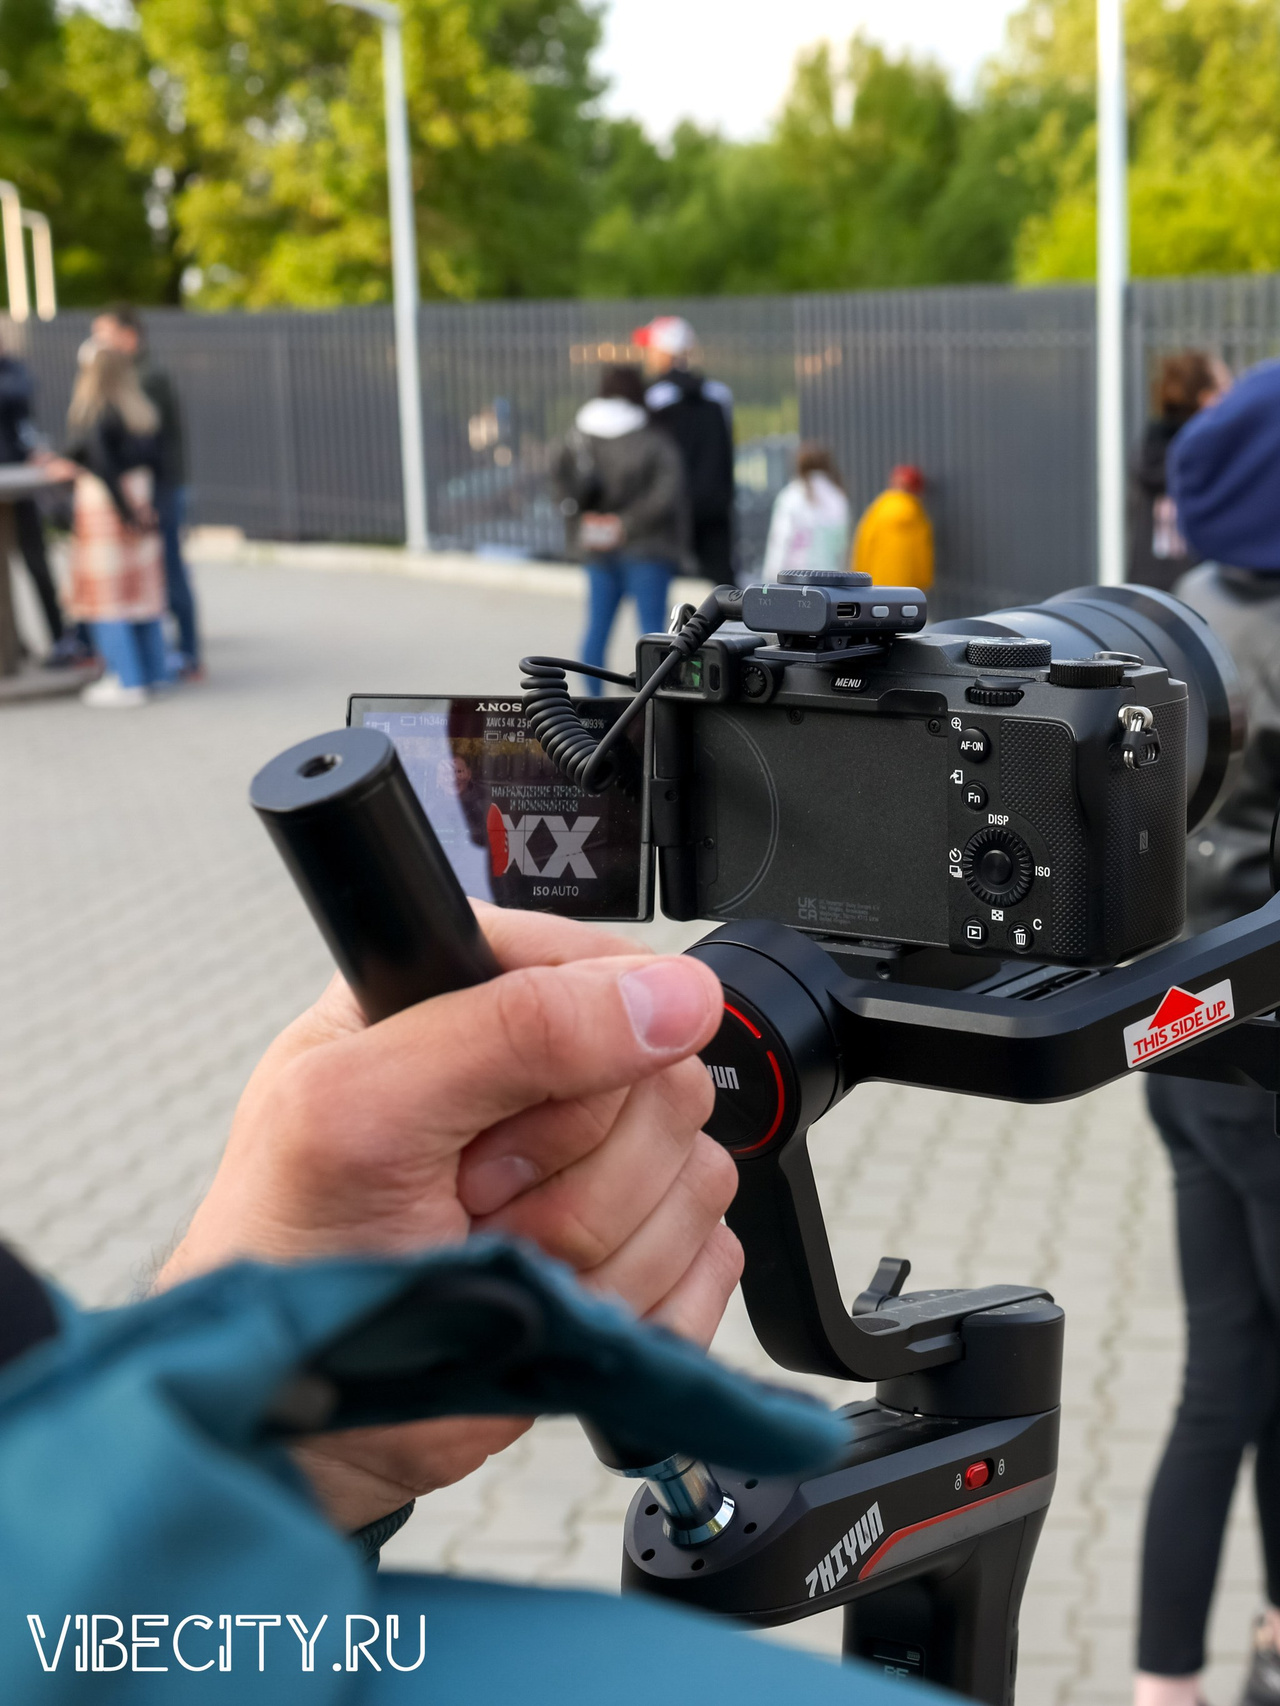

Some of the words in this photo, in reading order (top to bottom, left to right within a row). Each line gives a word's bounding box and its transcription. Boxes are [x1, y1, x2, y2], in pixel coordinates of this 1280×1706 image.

[759, 598, 772, 606] TX1
[798, 600, 812, 609] TX2
[834, 677, 862, 688] MENU
[475, 702, 522, 712] SONY
[419, 715, 448, 726] 1h34m
[507, 717, 515, 727] 4K
[589, 718, 604, 729] 93%
[961, 740, 983, 751] AF-ON
[968, 793, 981, 803] Fn
[988, 814, 1009, 825] DISP
[1035, 866, 1050, 877] ISO
[533, 887, 549, 896] ISO
[551, 886, 579, 896] AUTO
[1033, 919, 1042, 930] C
[1133, 1028, 1168, 1056] THIS
[1171, 1011, 1203, 1038] SIDE
[1206, 1000, 1226, 1021] UP
